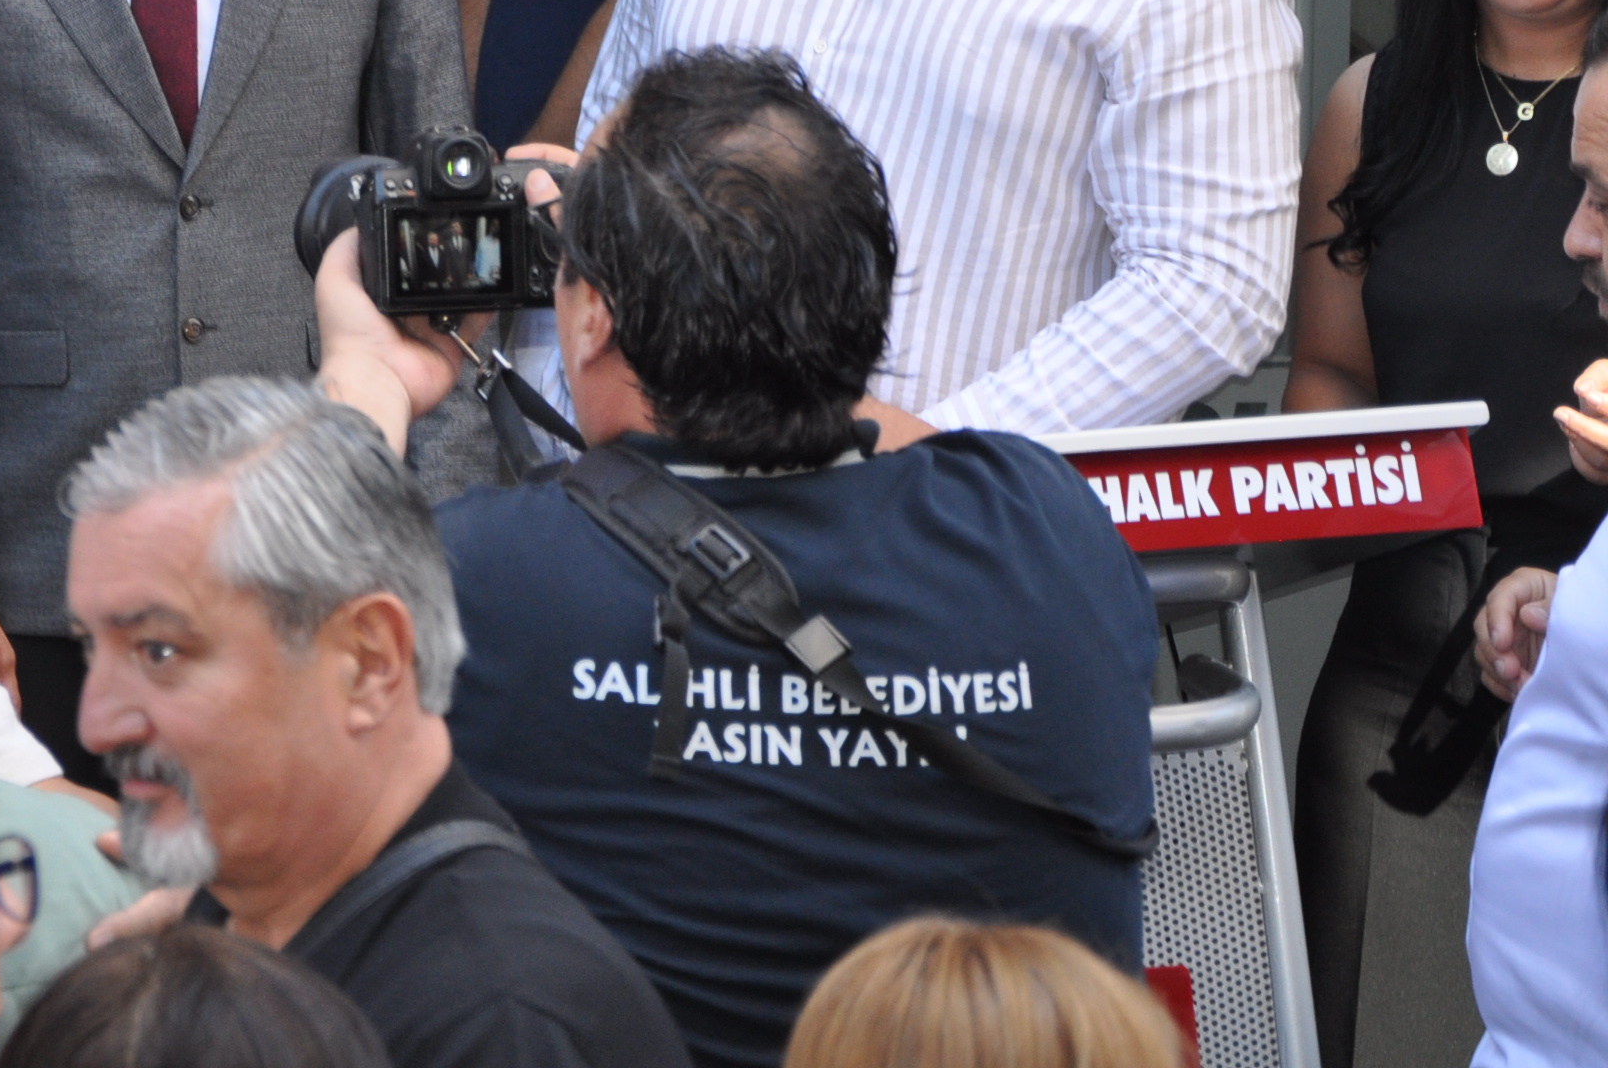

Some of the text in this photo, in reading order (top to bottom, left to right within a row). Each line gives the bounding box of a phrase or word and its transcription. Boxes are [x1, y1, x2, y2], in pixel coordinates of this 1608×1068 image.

[1088, 440, 1423, 524] HALK PARTİSİ
[573, 659, 761, 712] SALHLİ
[654, 720, 803, 766] ASIN
